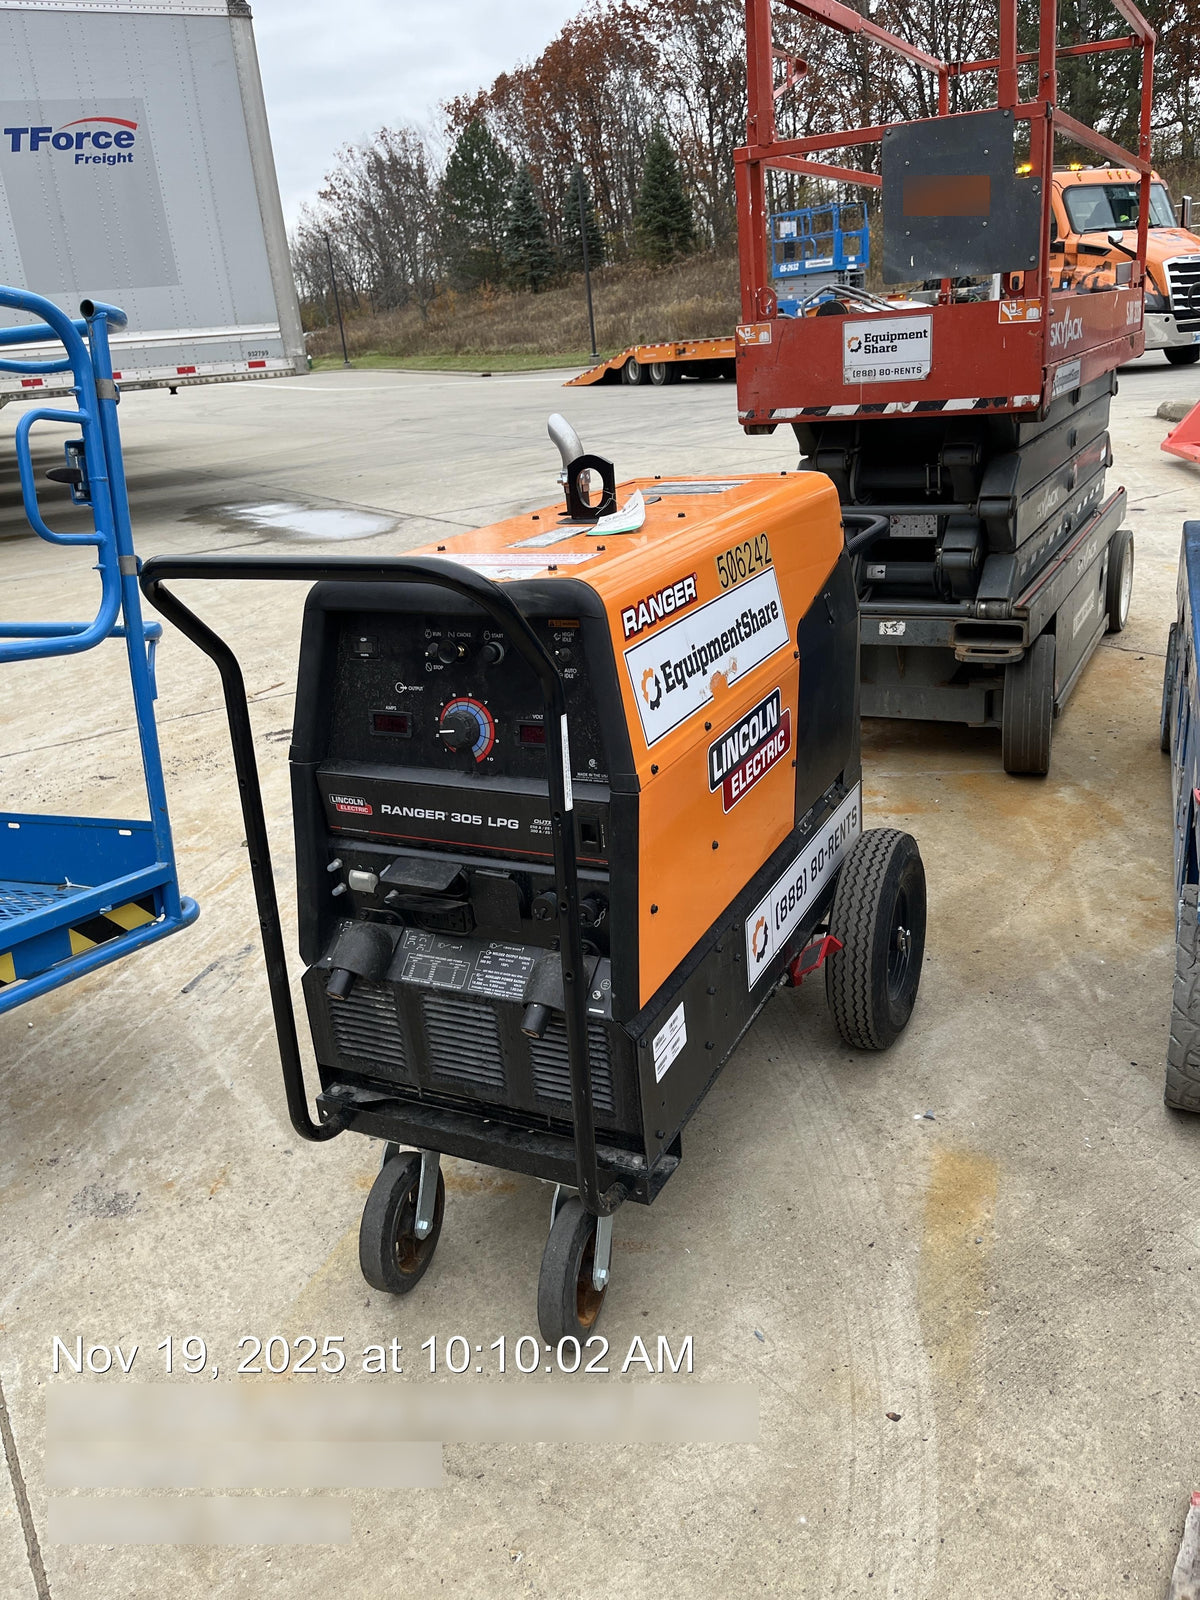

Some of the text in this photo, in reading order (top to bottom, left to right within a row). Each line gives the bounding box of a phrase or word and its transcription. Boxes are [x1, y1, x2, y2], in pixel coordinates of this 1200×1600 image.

[4, 126, 136, 153] TForce
[74, 152, 134, 166] Freight
[864, 329, 928, 344] Equipment
[1049, 305, 1083, 350] SKYJACK
[864, 344, 898, 354] Share
[879, 366, 922, 376] 80-RENTS
[715, 533, 773, 590] 506242
[622, 575, 697, 638] RANGER
[660, 600, 779, 694] EquipmentShare
[712, 697, 778, 783] LINCOLN
[731, 730, 785, 800] ELECTRIC
[331, 795, 364, 807] LINCOLN
[340, 804, 369, 813] ELECTRIC
[381, 804, 446, 821] RANGER
[450, 812, 482, 825] 305
[487, 816, 520, 830] LPG
[775, 804, 858, 931] (888) 80-RENTS
